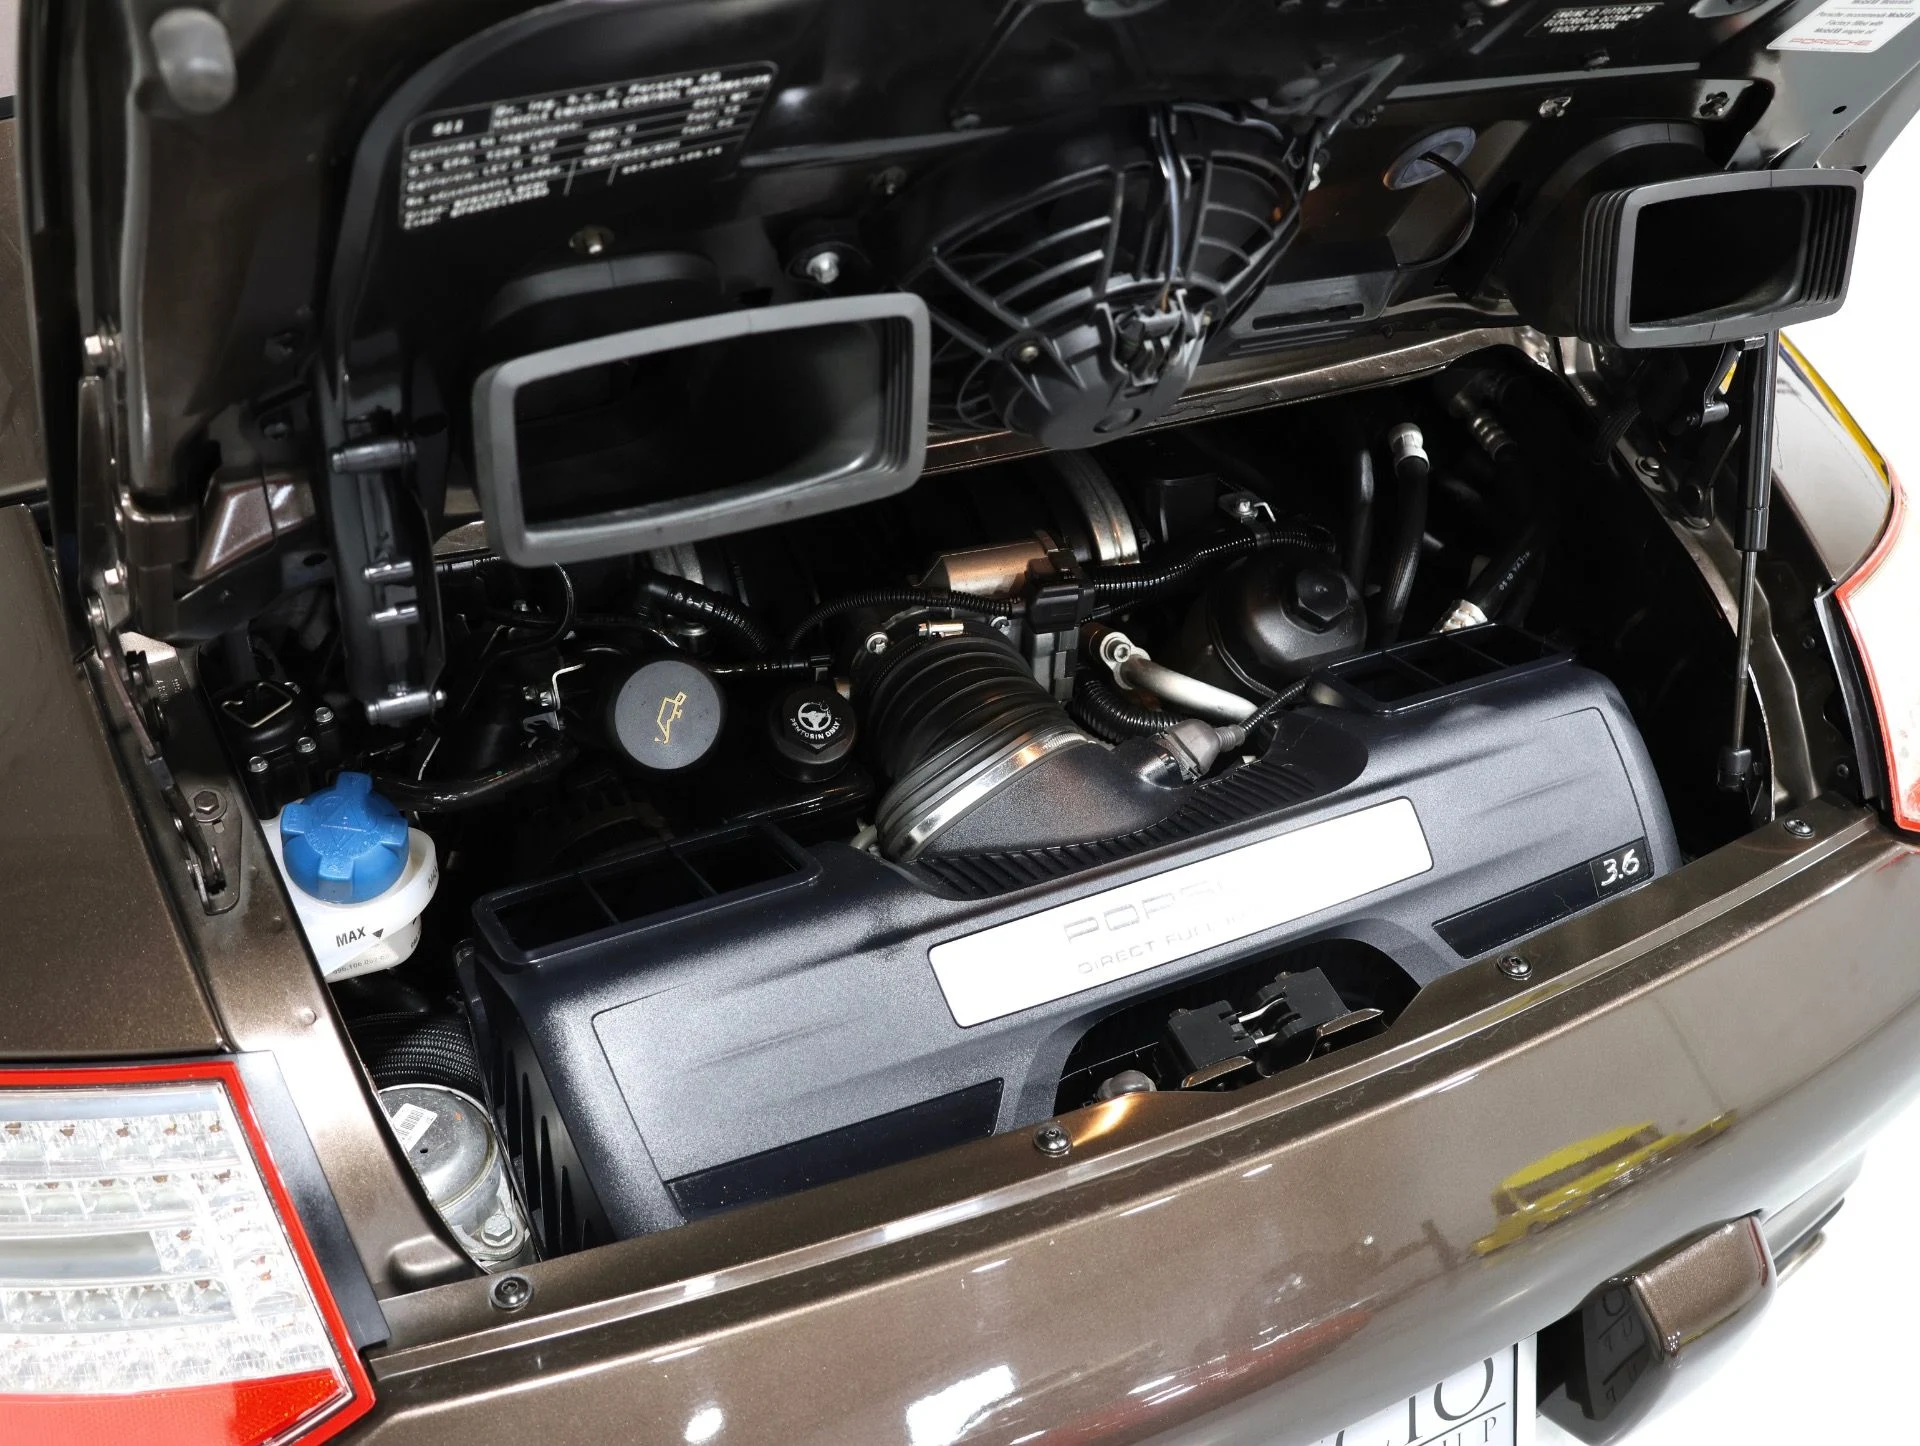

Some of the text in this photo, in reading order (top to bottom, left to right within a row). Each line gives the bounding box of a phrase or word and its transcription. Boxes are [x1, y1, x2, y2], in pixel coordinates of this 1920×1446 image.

[789, 717, 825, 740] PENTOSIN
[1600, 847, 1640, 887] 3.6
[335, 926, 367, 948] MAX
[1077, 940, 1155, 975] DIRECT
